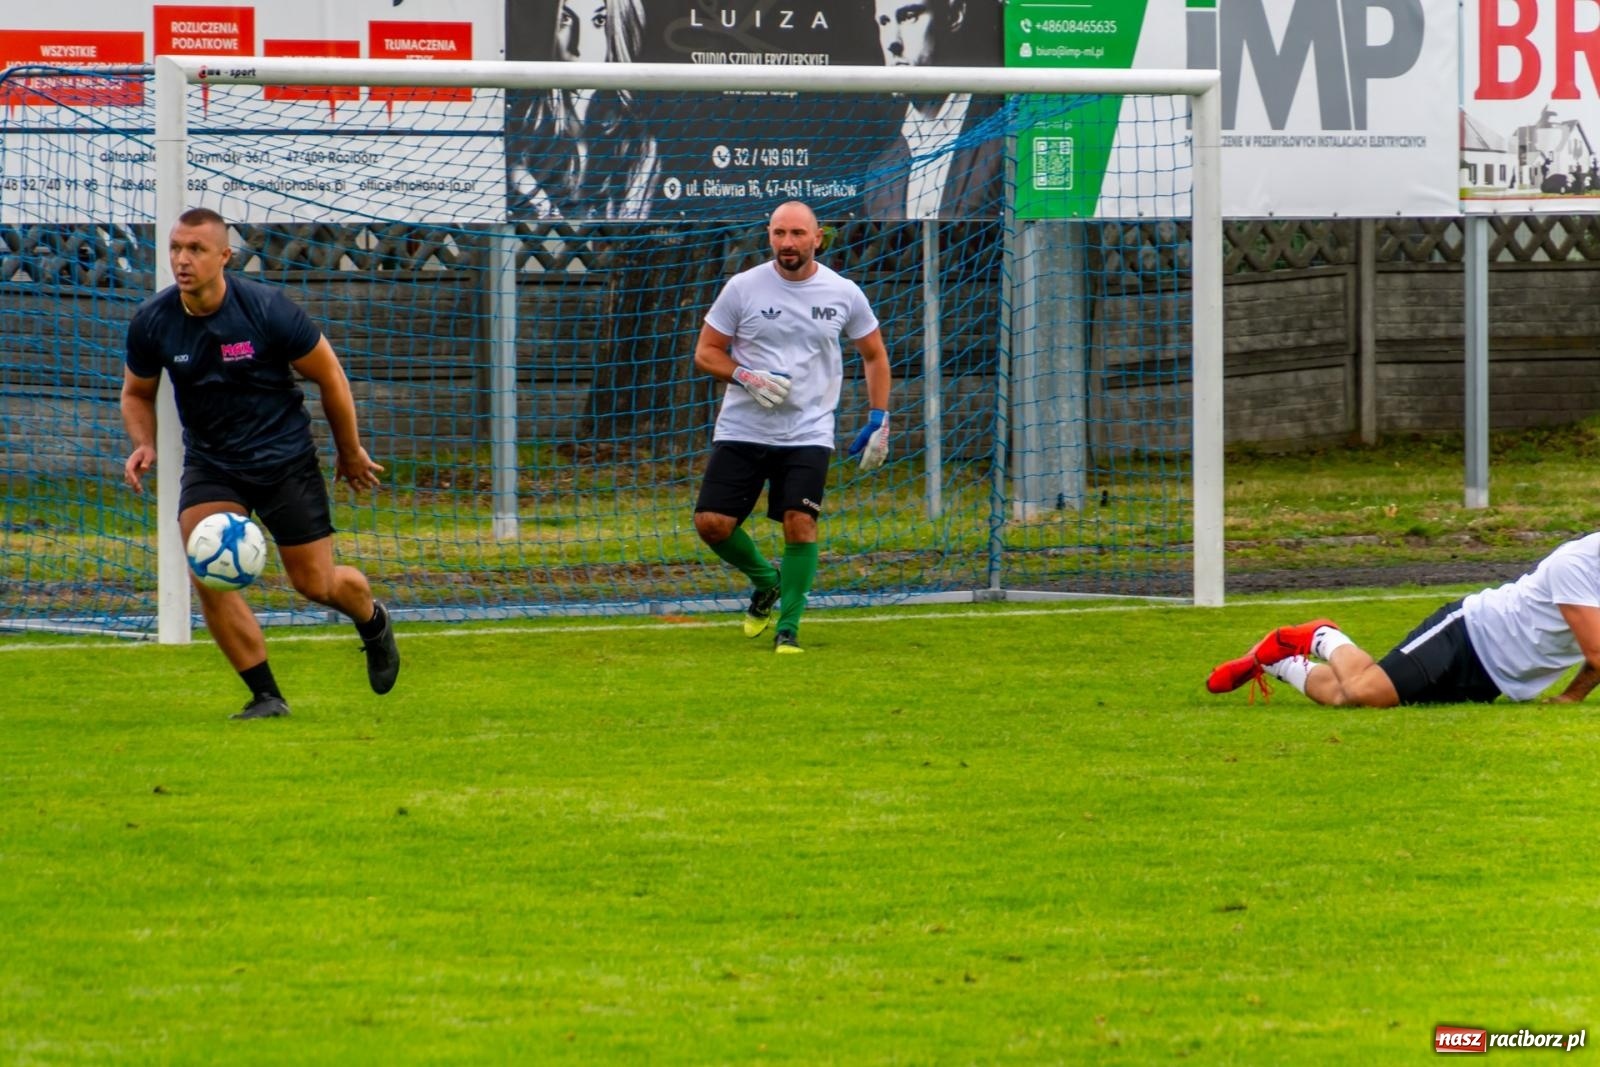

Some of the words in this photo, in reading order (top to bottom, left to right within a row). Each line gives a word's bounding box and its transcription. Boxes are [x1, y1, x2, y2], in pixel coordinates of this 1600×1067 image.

[690, 9, 829, 29] LUIZA
[171, 21, 238, 34] ROZLICZENIA
[1036, 20, 1117, 33] +48608465635
[172, 38, 238, 50] PODATKOWE
[384, 38, 456, 51] TŁUMACZENIA
[1474, 0, 1600, 99] BR
[40, 45, 97, 57] WSZYSTKIE
[230, 67, 256, 79] sport
[734, 148, 750, 166] 32
[760, 148, 779, 166] 419
[782, 148, 794, 166] 61
[796, 148, 809, 166] 21
[703, 179, 745, 197] Główna
